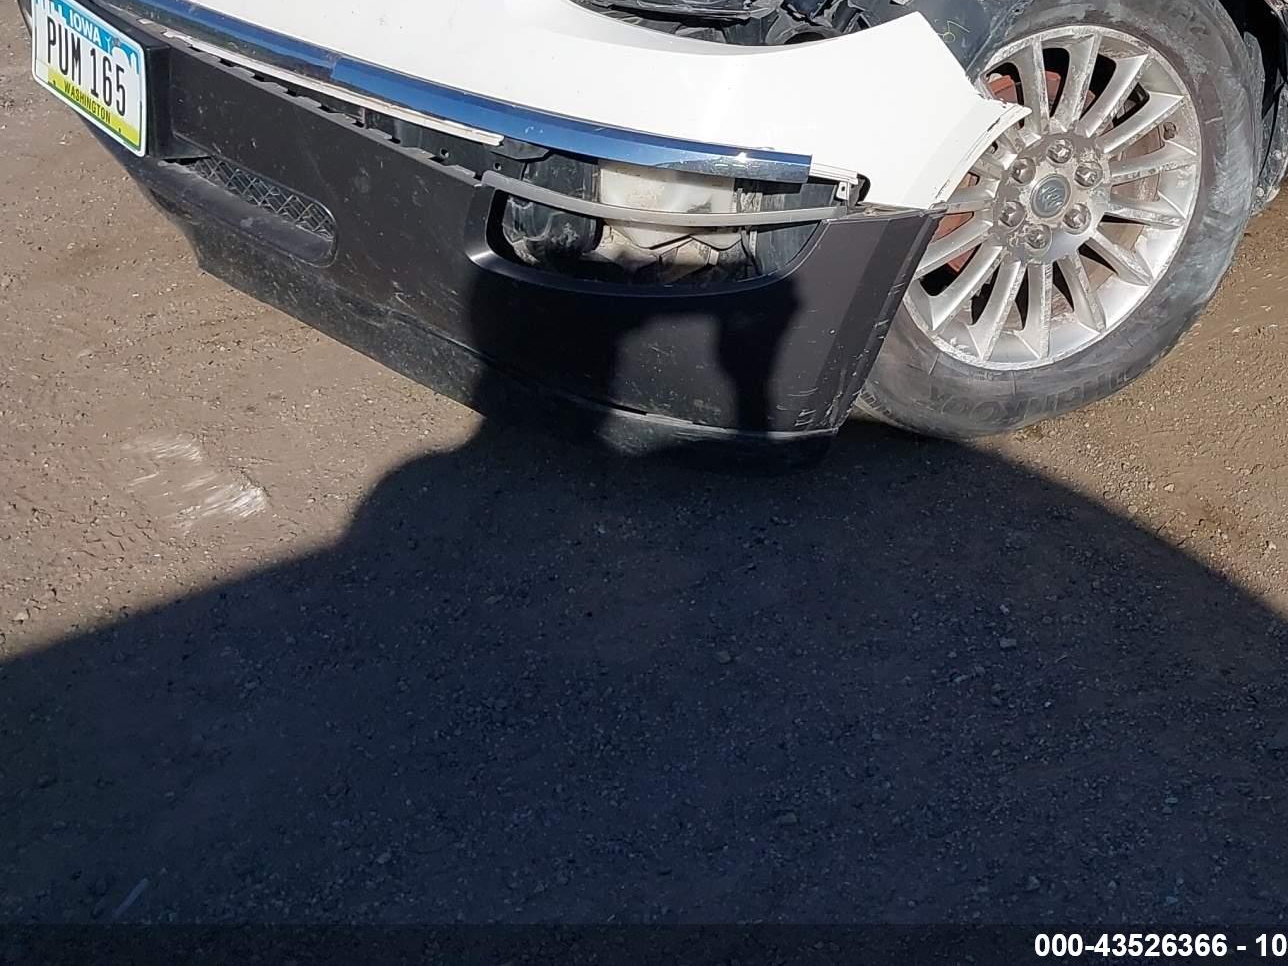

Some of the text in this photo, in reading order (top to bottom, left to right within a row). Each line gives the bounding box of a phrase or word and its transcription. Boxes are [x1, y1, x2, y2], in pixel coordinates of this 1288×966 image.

[69, 11, 102, 47] IOWA
[46, 15, 127, 117] PUM 165
[63, 80, 112, 125] WASHINGTON
